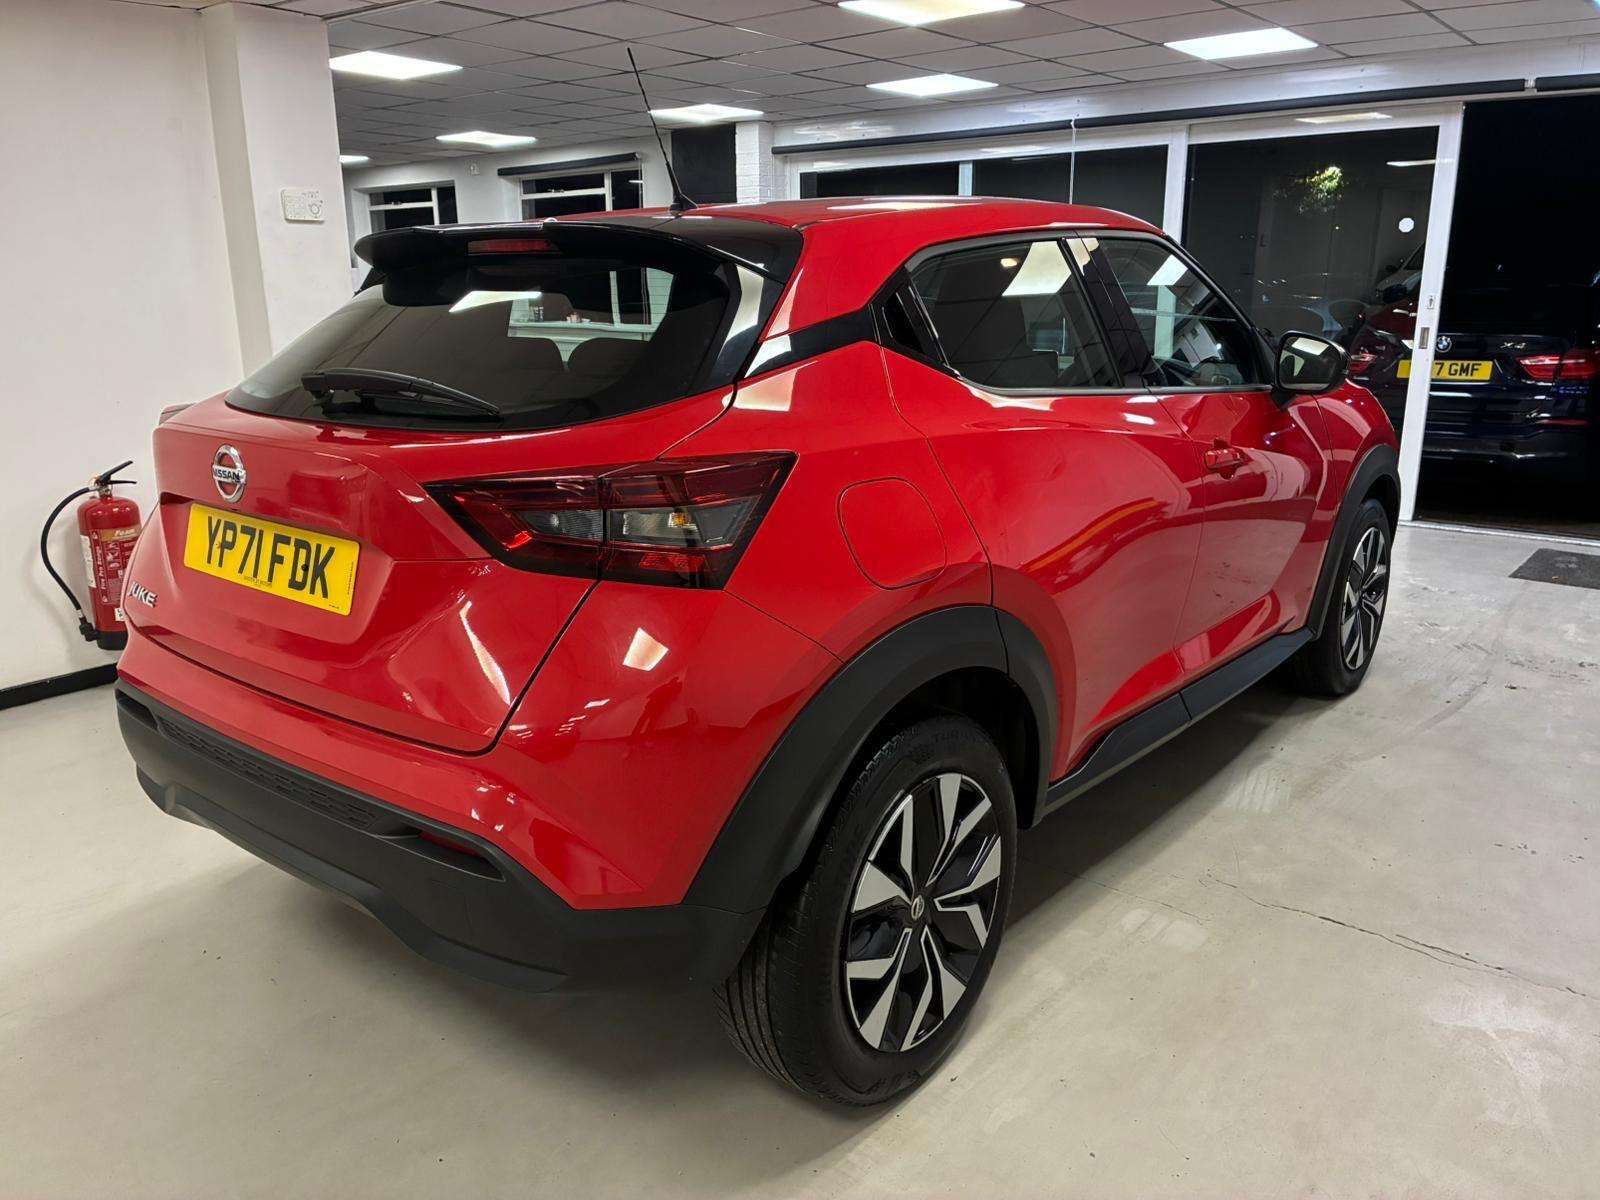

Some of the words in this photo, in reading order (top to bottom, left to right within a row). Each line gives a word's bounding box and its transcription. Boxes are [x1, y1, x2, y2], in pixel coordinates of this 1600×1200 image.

[1448, 362, 1482, 377] GMF
[213, 468, 241, 482] NISSAN
[206, 515, 264, 579] YP71
[267, 532, 336, 600] FDK
[127, 581, 158, 609] JUKE
